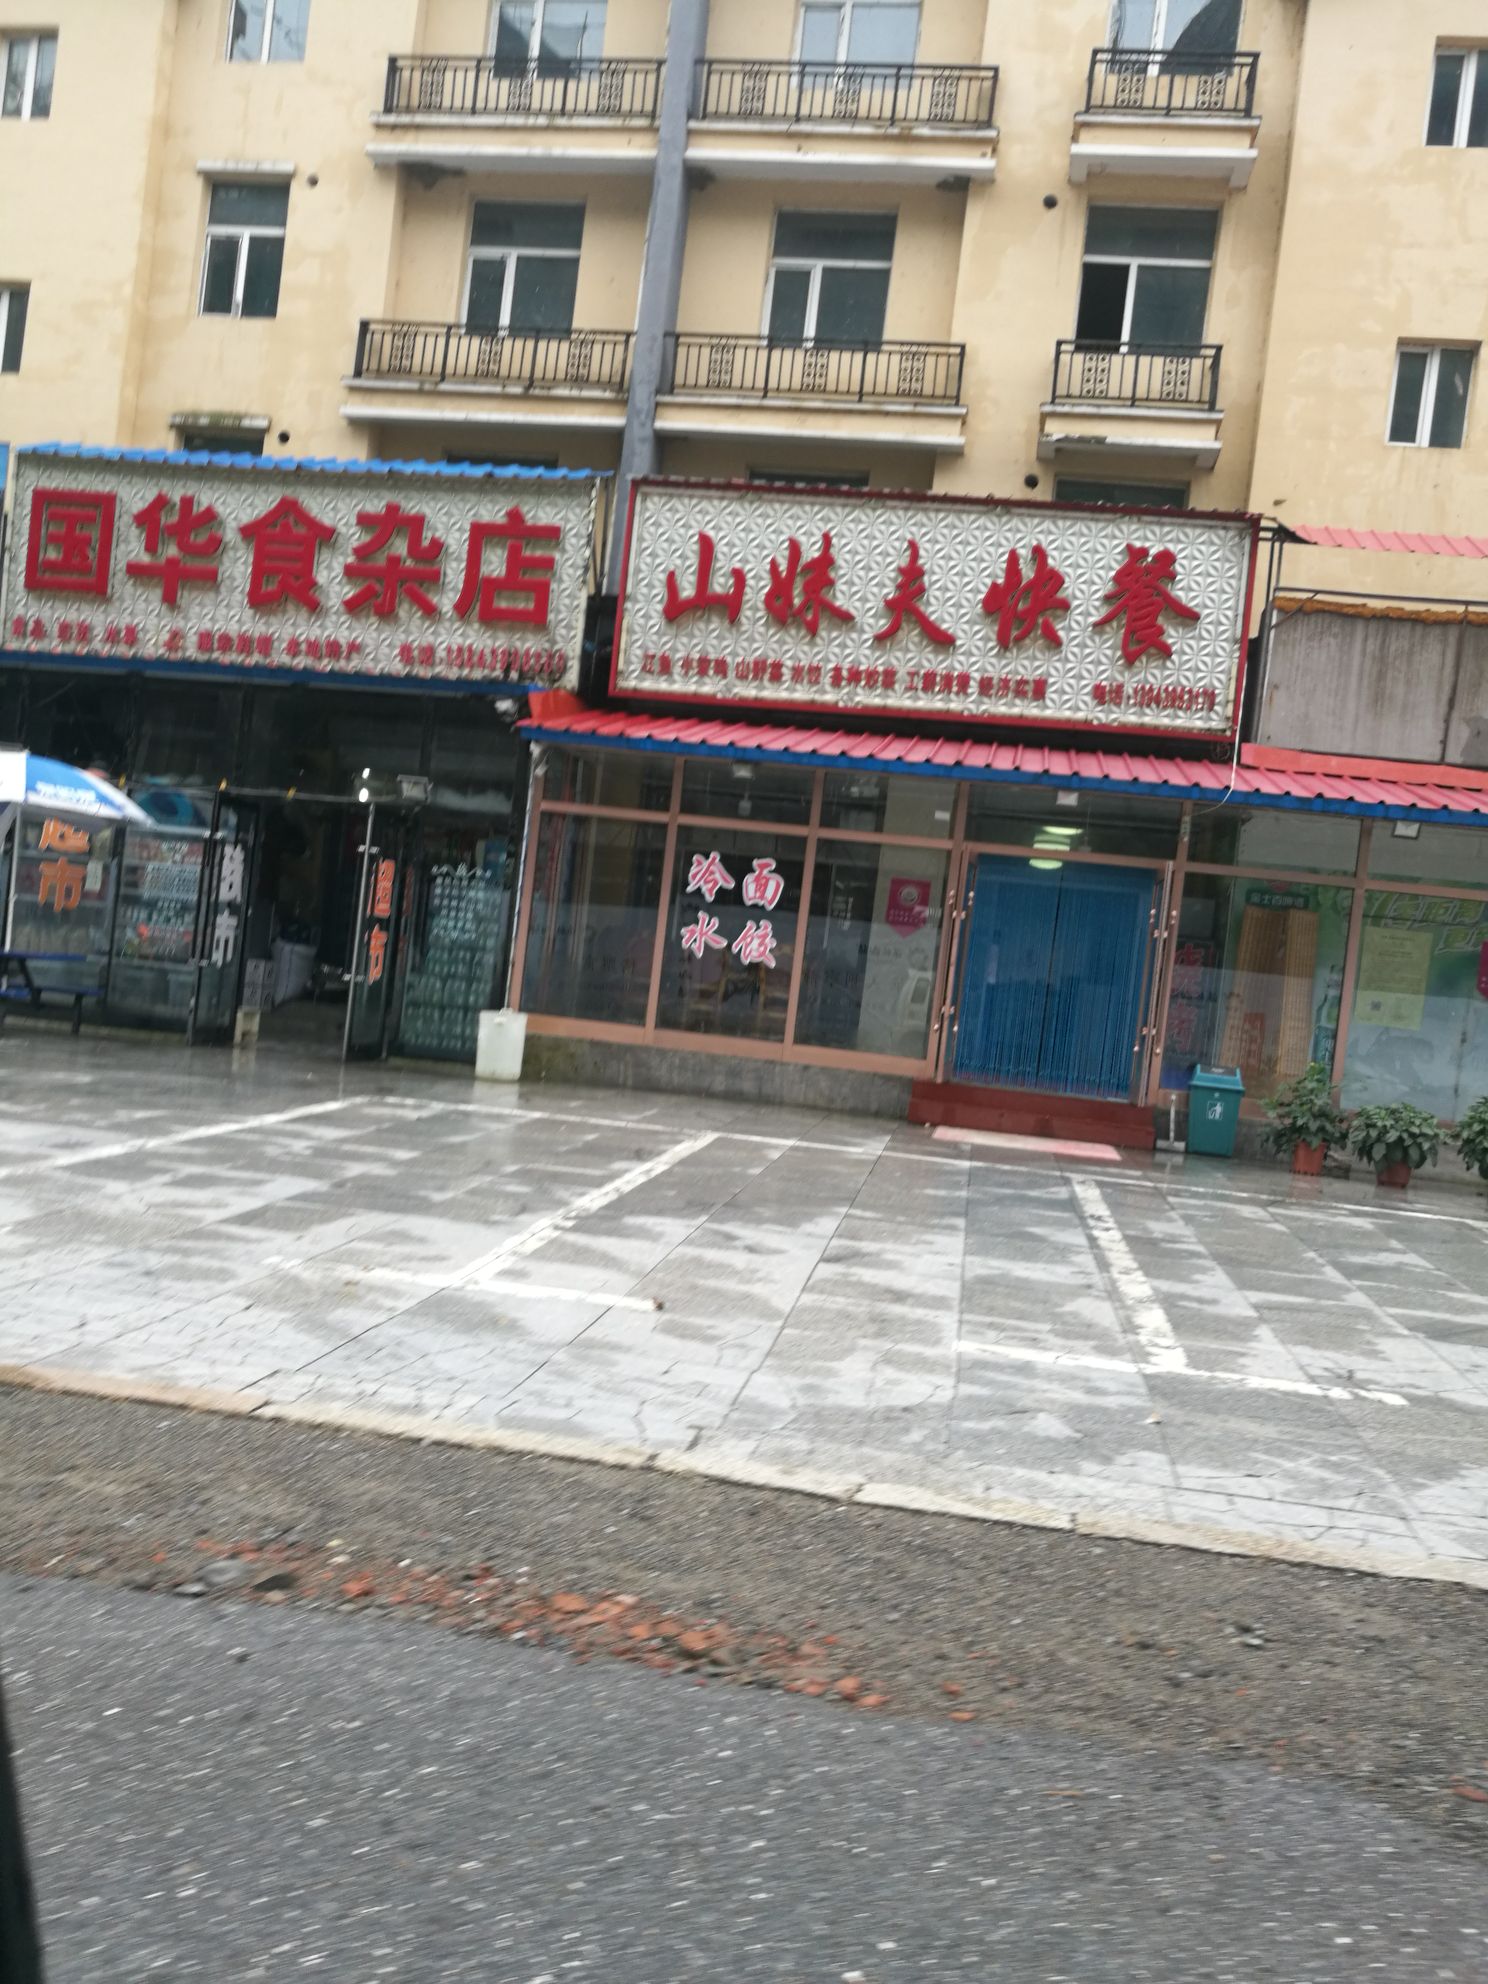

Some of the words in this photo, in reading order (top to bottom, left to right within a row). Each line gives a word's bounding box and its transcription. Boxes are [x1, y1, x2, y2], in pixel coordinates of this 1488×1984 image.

[24, 488, 562, 626] 国华食杂店
[663, 530, 1200, 666] 山妹夫快餐
[686, 851, 784, 911] 冷面
[681, 910, 777, 969] 水饺
